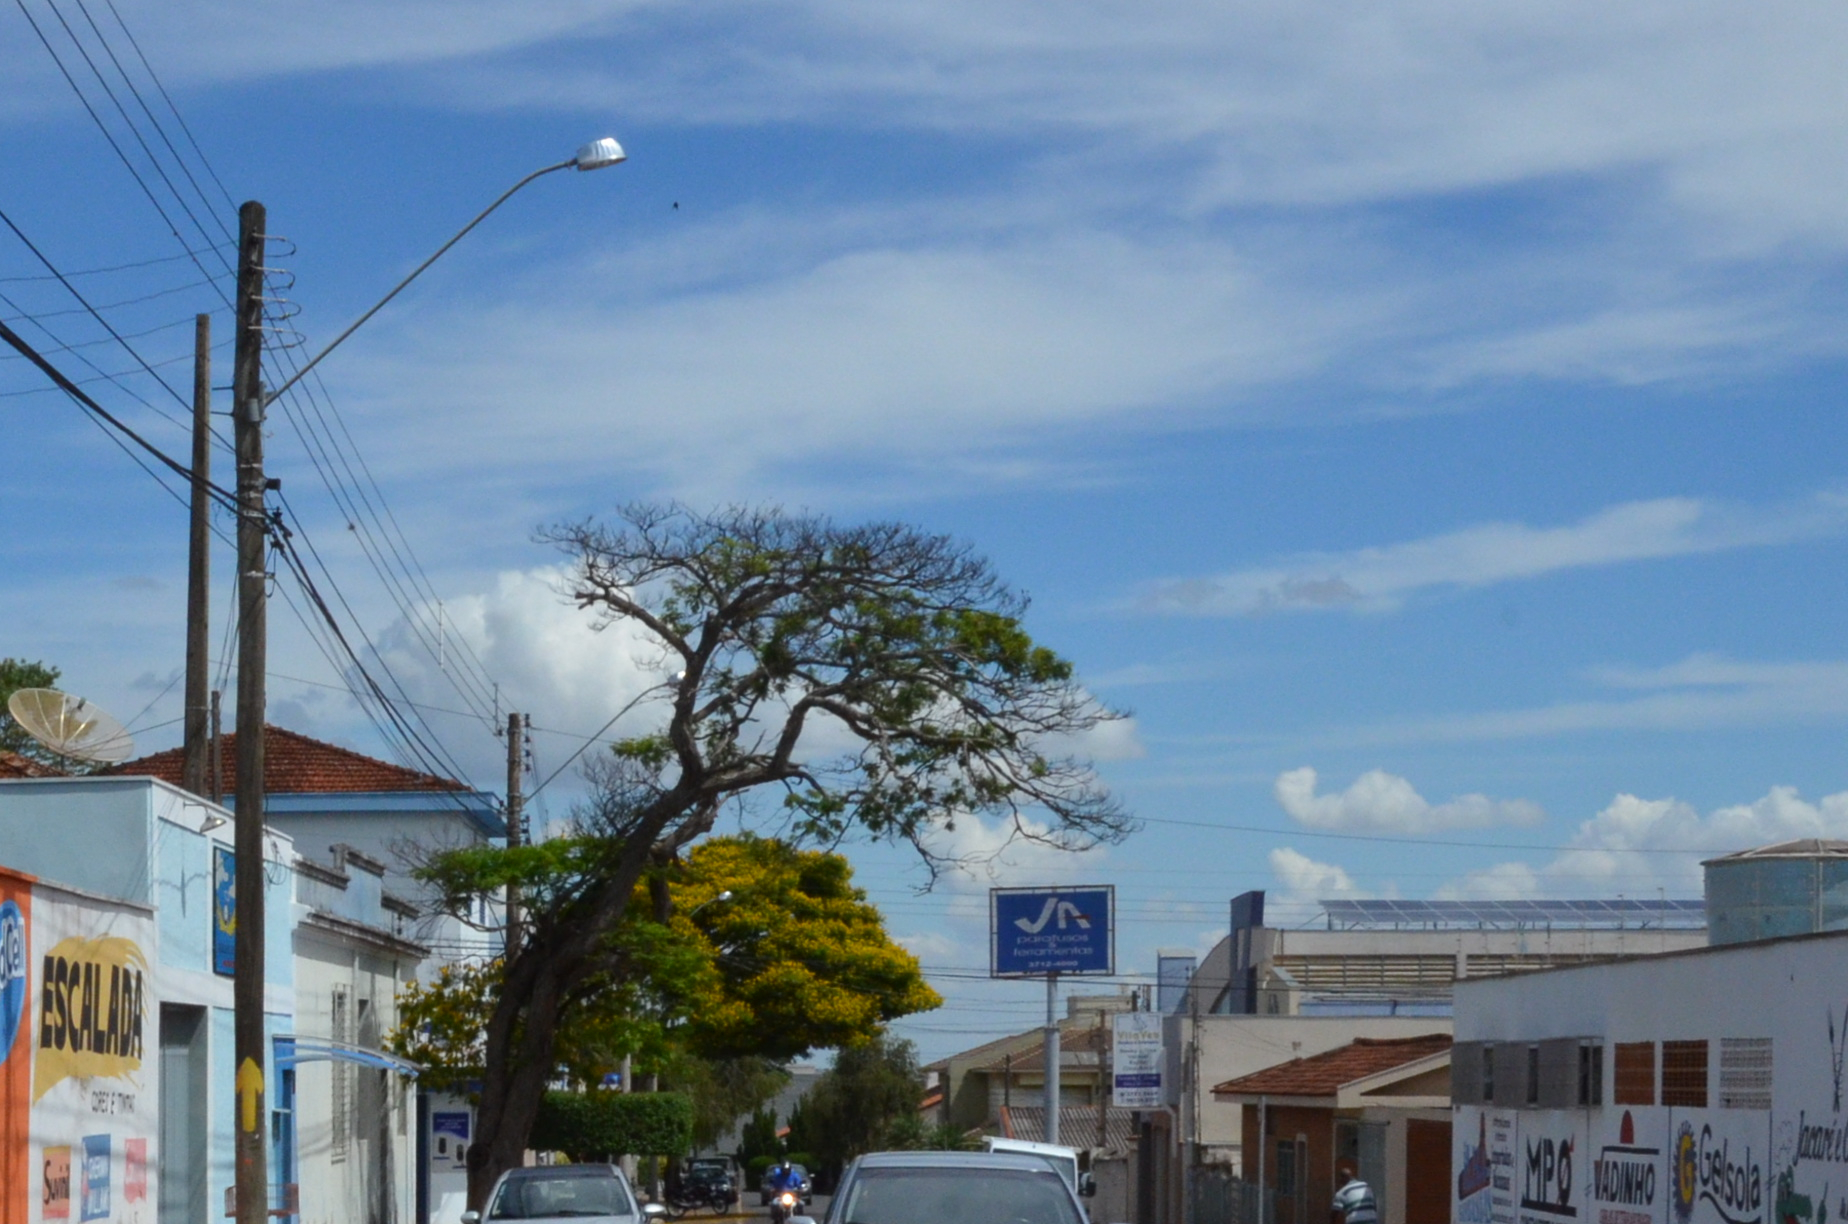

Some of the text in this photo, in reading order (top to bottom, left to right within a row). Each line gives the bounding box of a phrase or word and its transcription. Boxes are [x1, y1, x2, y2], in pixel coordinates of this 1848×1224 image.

[39, 956, 143, 1060] ESCALADA
[1594, 1160, 1655, 1206] VADINHO
[1699, 1123, 1761, 1212] Gelsola
